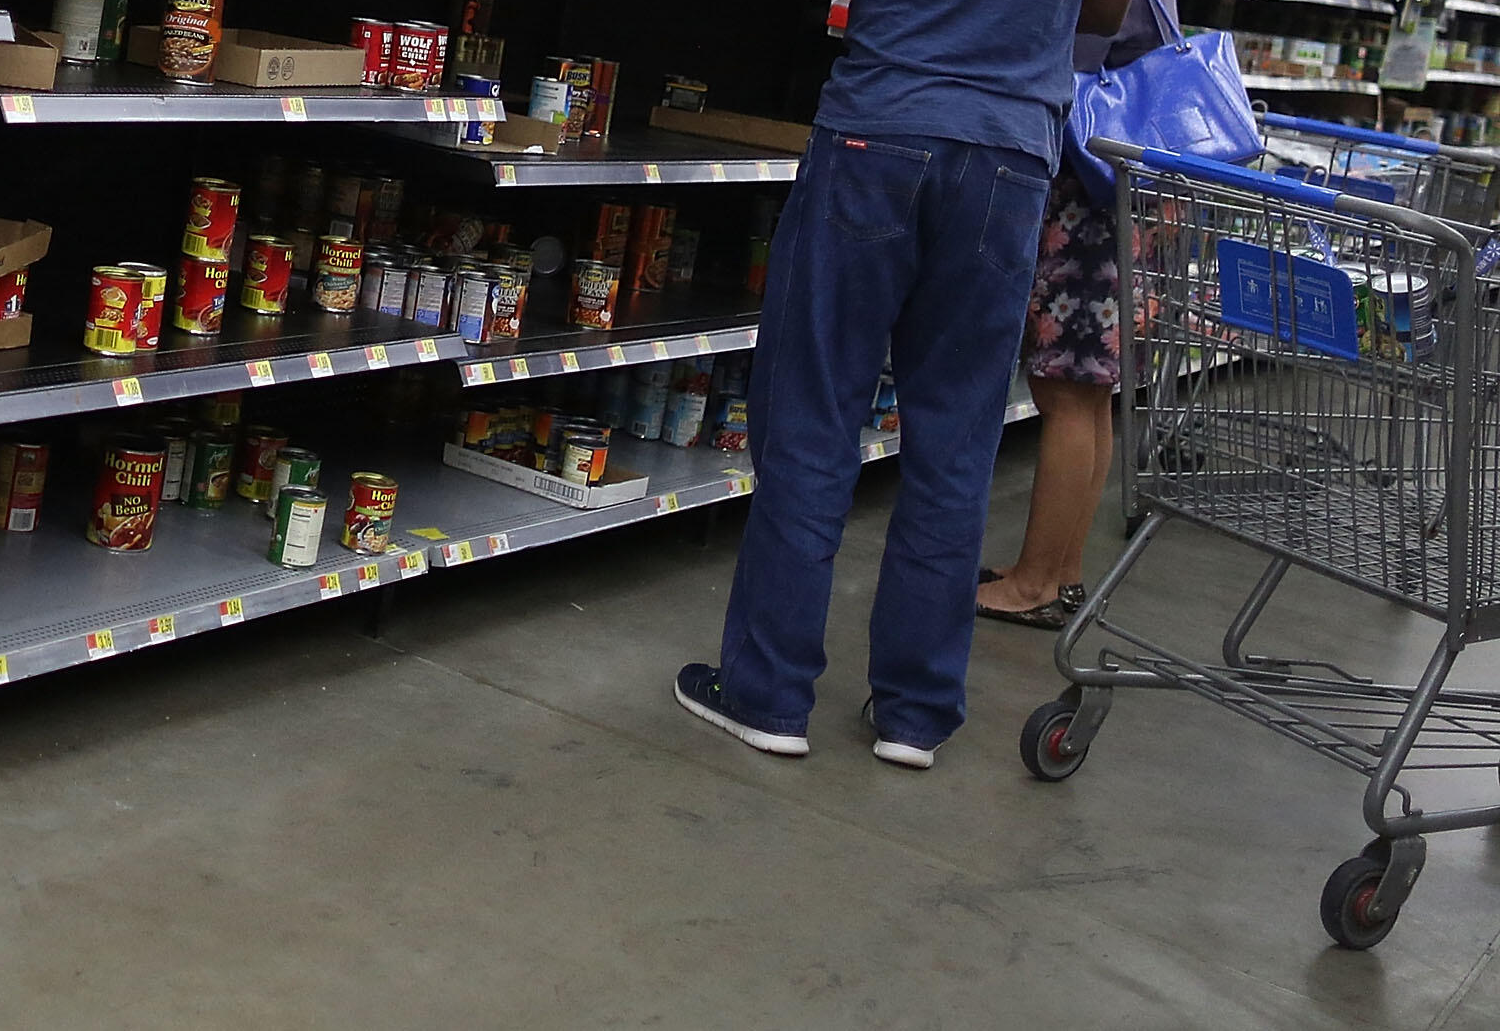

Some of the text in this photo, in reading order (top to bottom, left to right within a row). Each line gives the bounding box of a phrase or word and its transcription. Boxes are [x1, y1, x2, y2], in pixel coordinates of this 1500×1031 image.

[164, 13, 209, 28] Original
[400, 35, 433, 49] WOLF
[402, 51, 428, 61] CHILI
[566, 70, 588, 81] BUSH
[320, 244, 362, 259] Hormel
[328, 255, 353, 268] Chili
[104, 450, 163, 473] Hormel
[115, 471, 152, 487] Chili
[123, 496, 141, 507] NO
[115, 503, 149, 517] Beans
